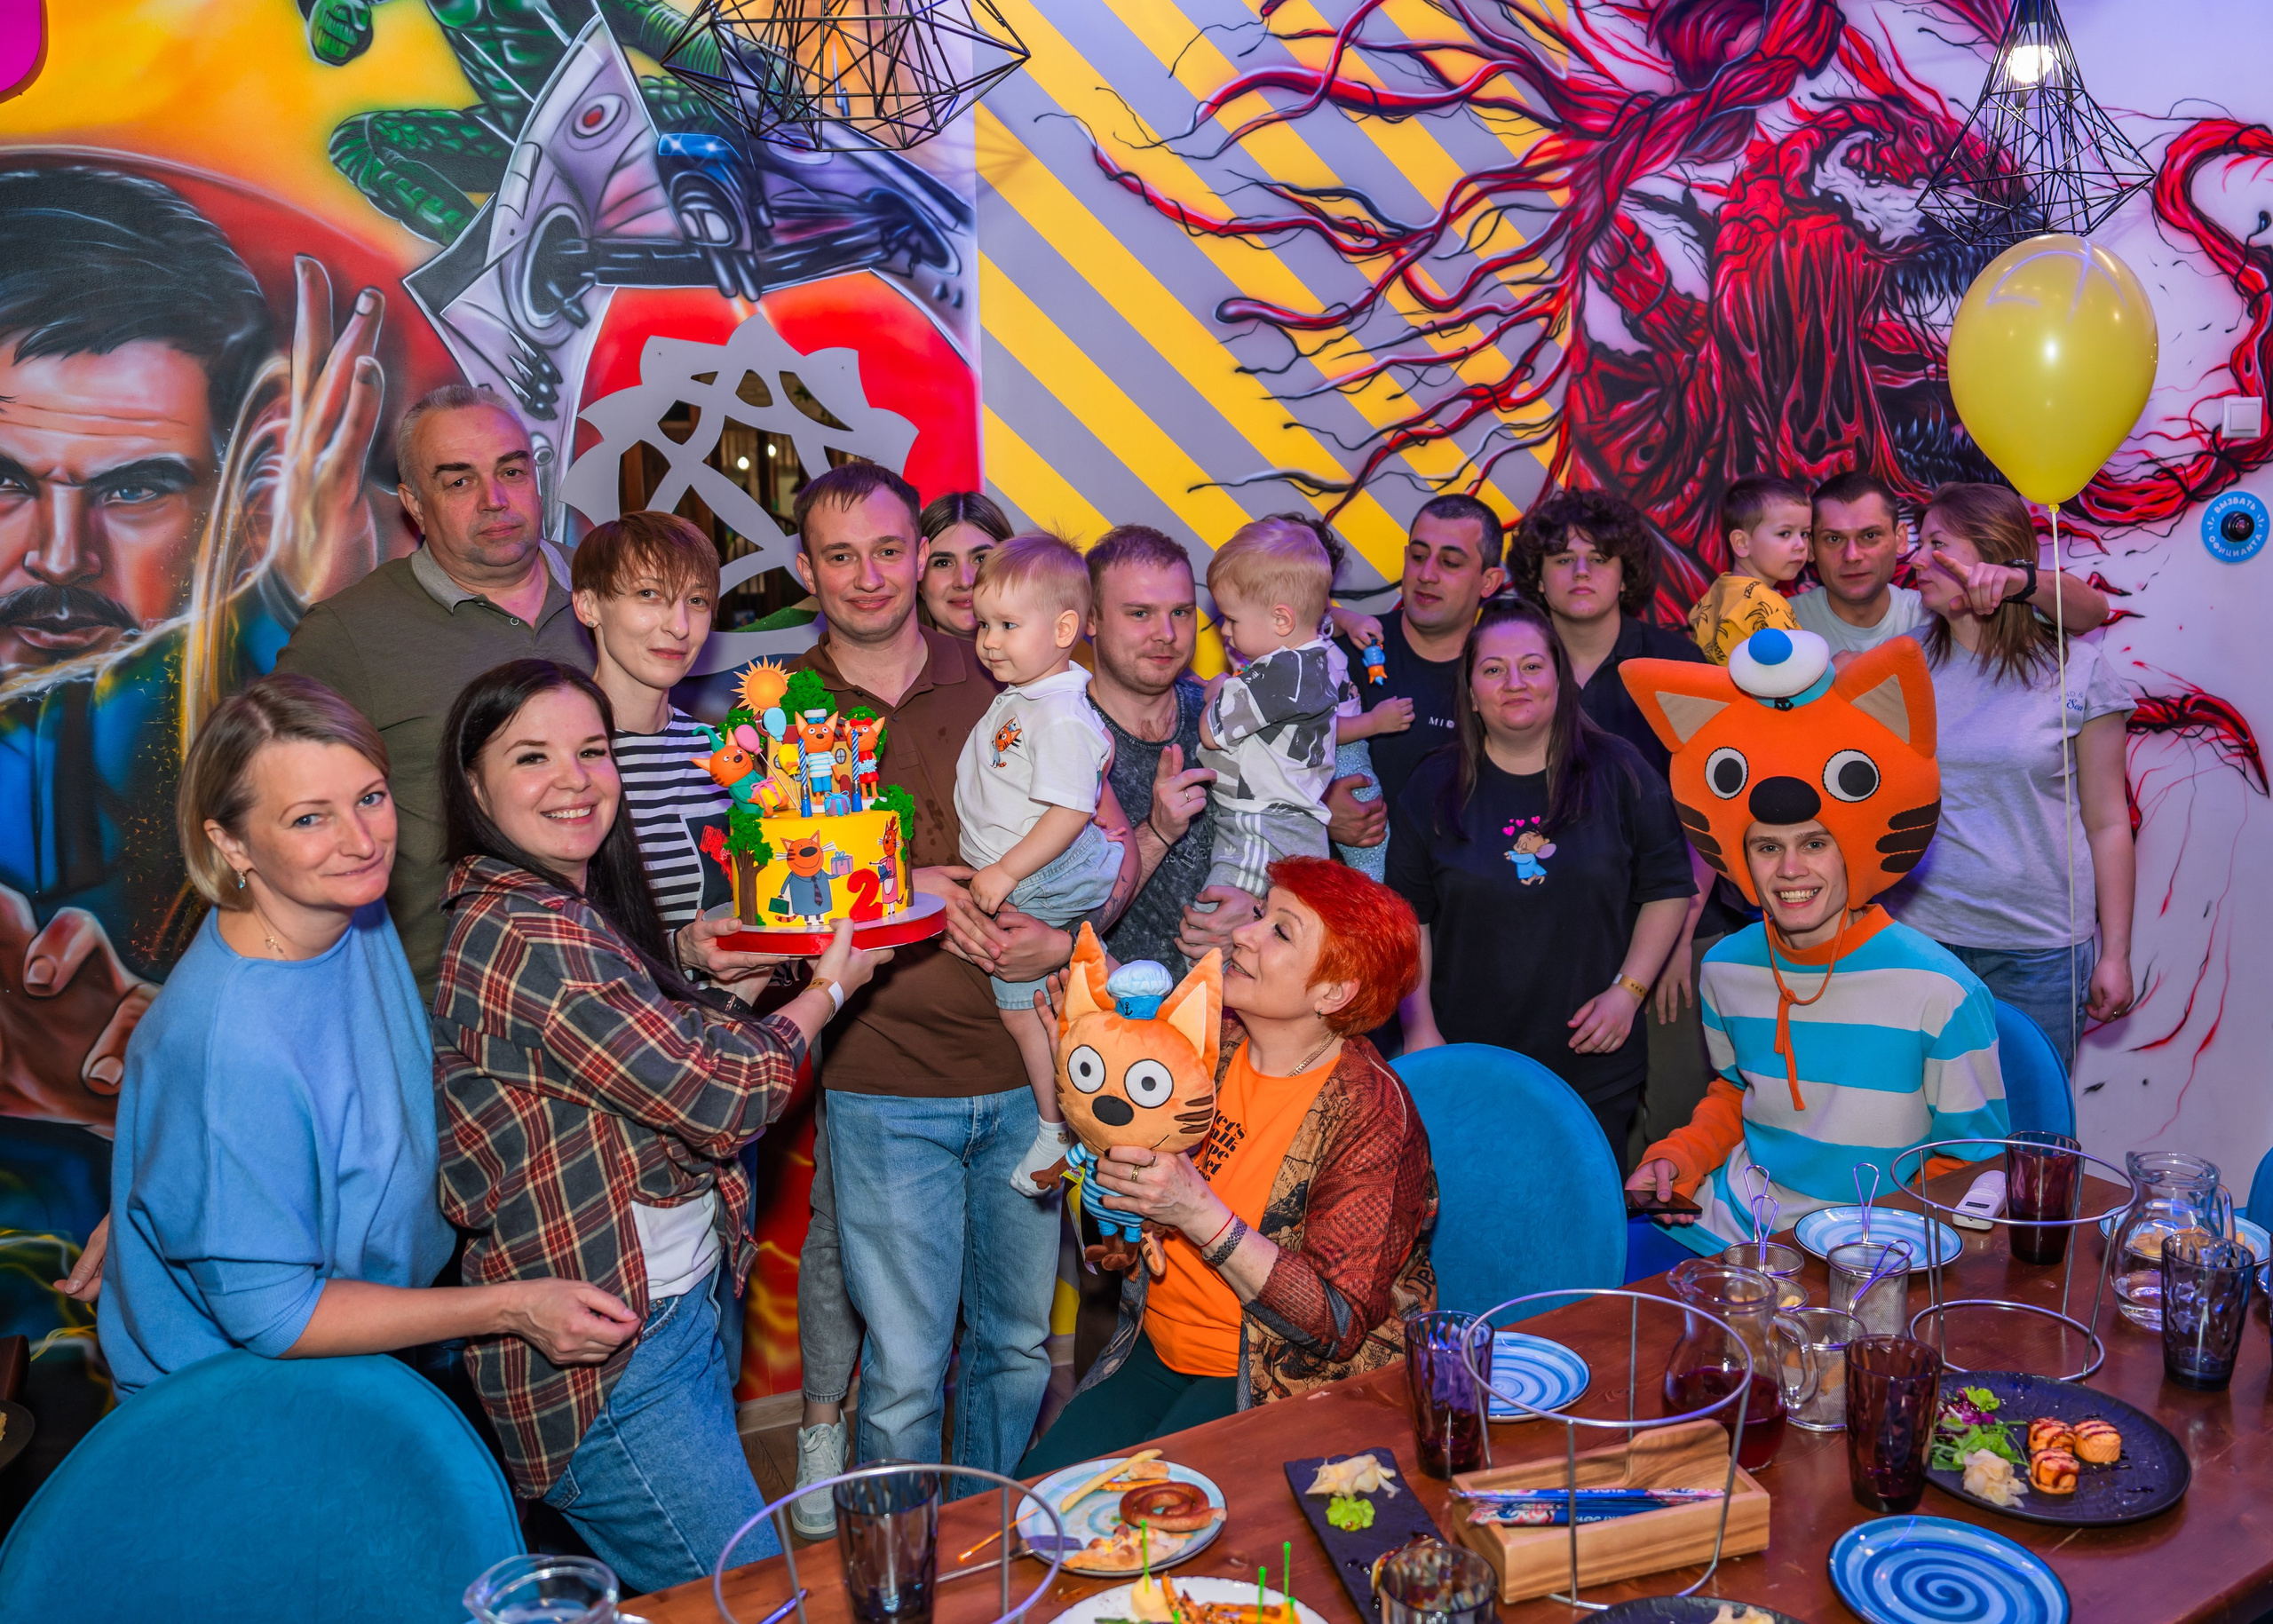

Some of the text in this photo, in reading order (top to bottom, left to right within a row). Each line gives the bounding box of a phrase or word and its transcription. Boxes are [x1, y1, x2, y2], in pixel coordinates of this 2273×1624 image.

[2214, 496, 2256, 514] ВЫЗВАТЬ
[2208, 534, 2262, 558] ОФИЦИАНТА
[2066, 698, 2083, 711] Sea
[846, 868, 884, 923] 2
[1209, 1127, 1239, 1153] alk
